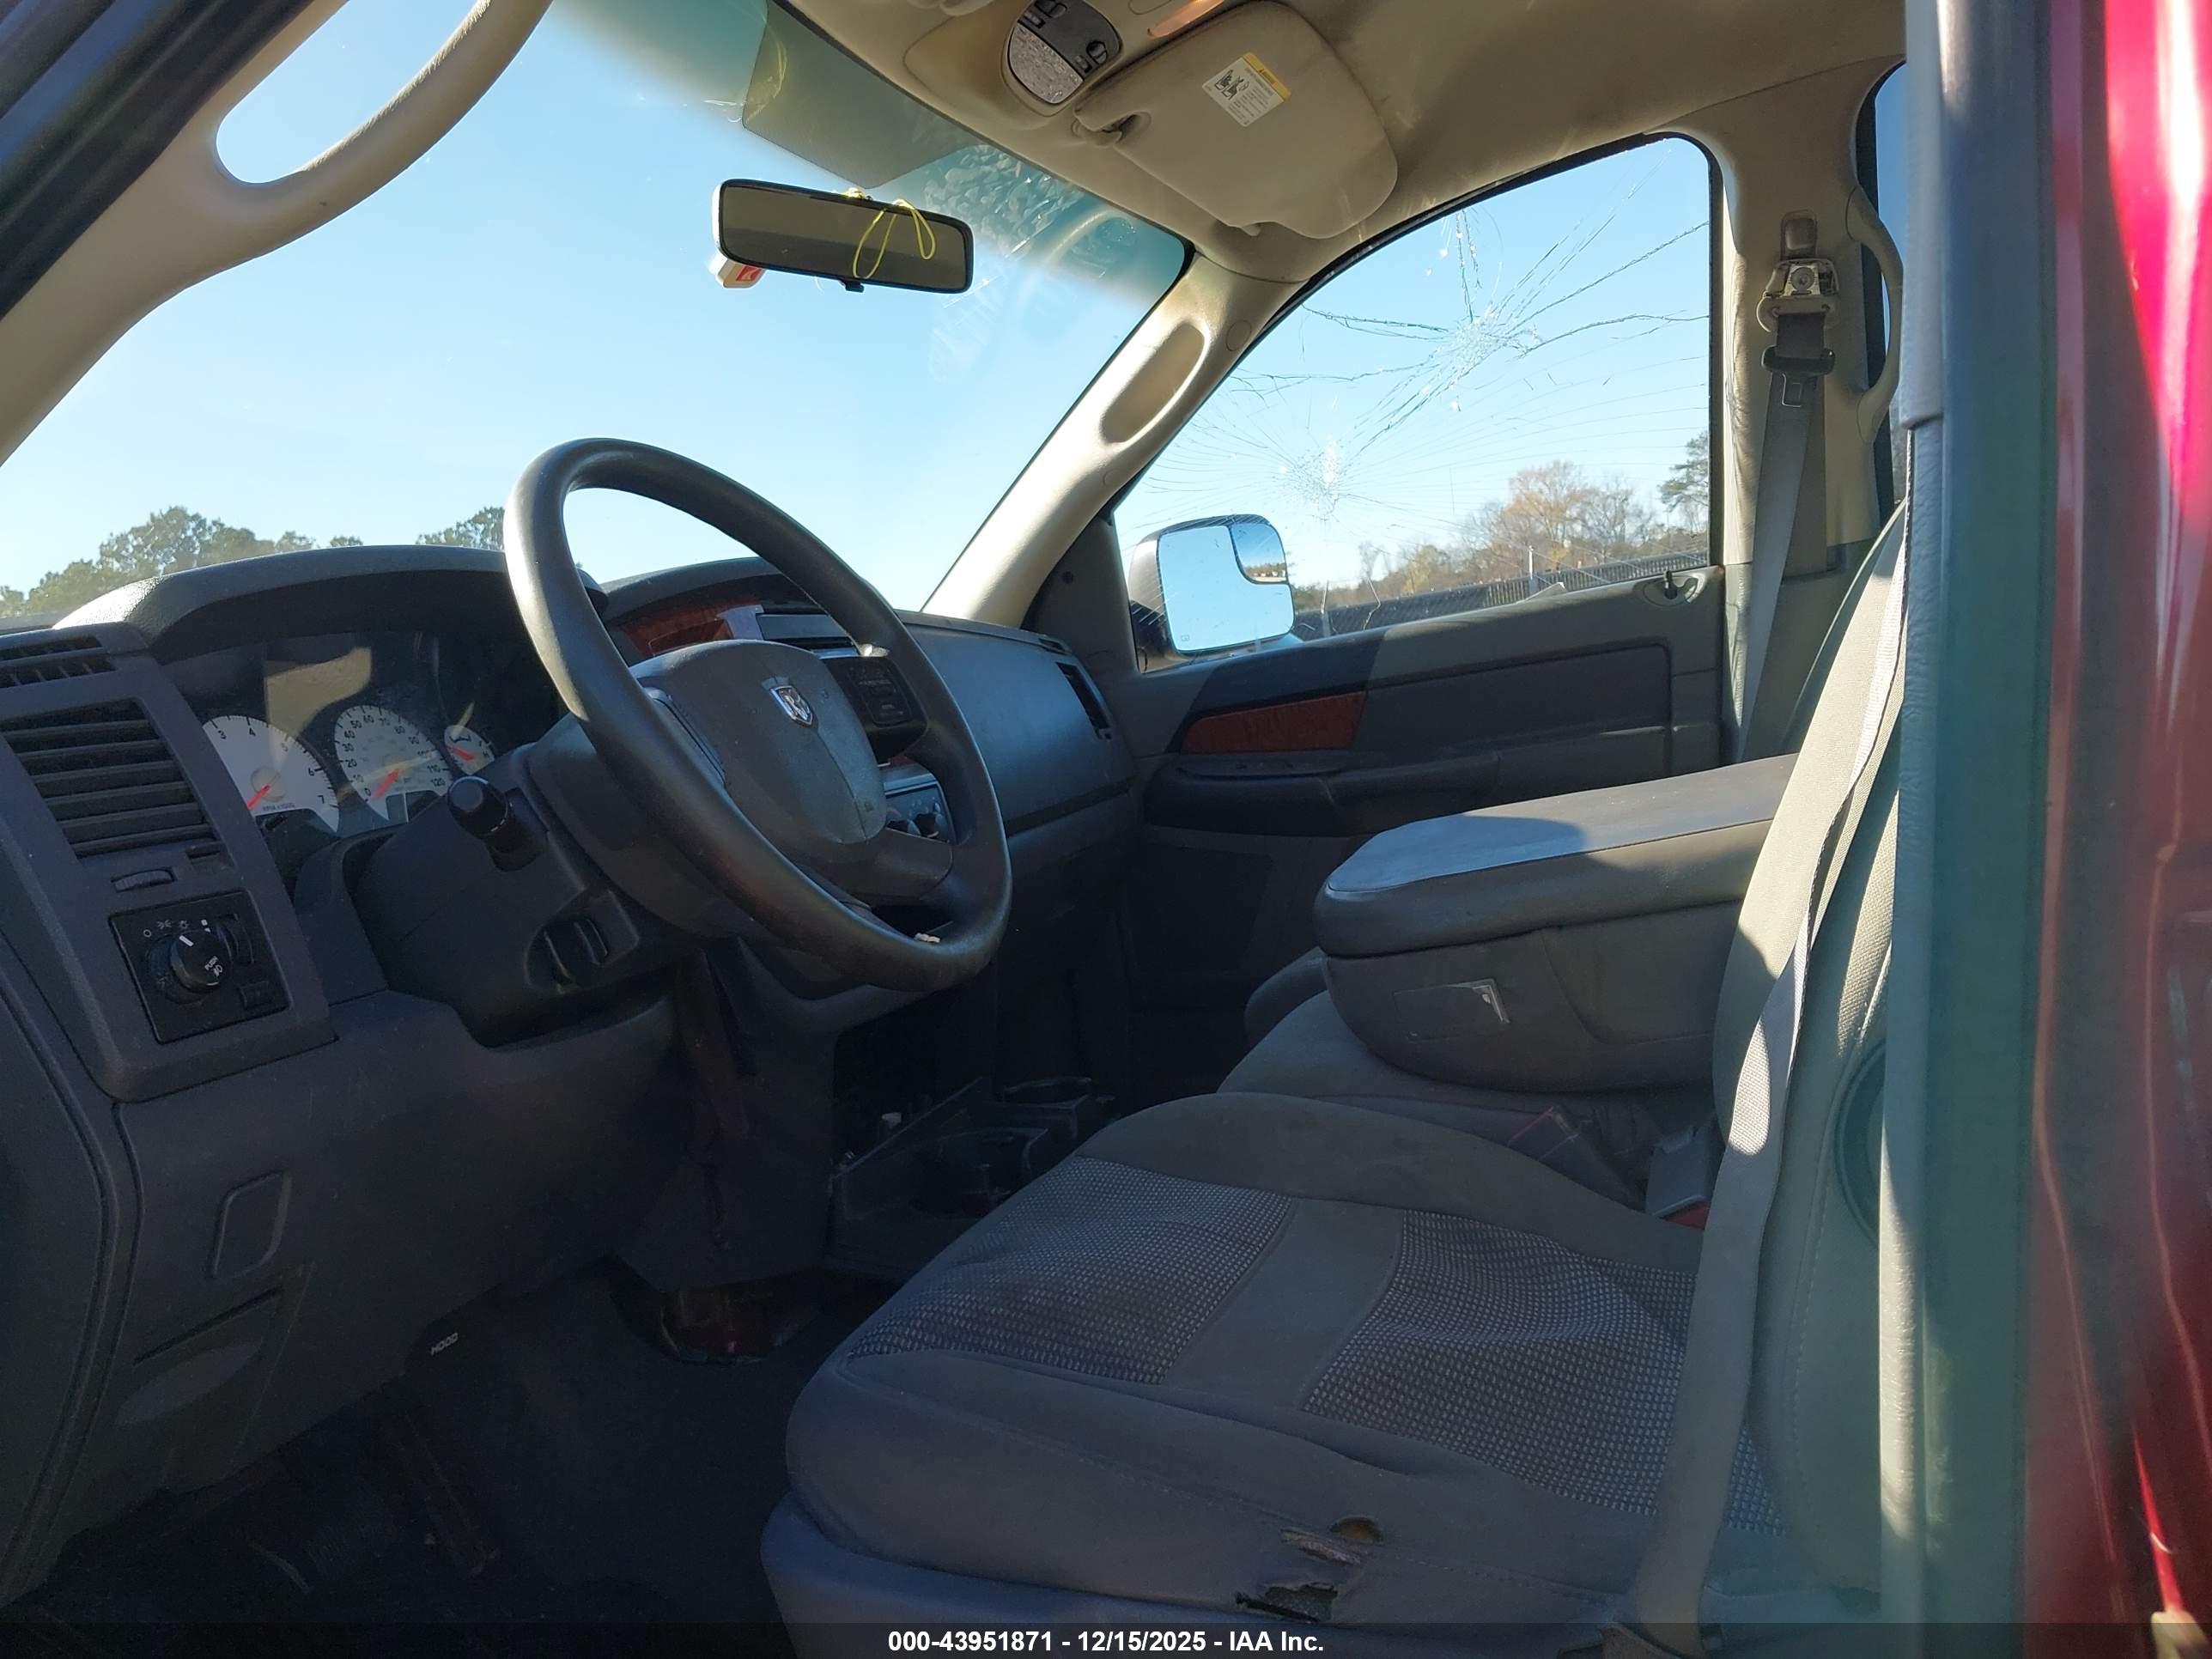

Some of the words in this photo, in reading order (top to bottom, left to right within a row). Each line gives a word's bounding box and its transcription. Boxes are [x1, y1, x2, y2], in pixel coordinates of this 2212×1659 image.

[349, 720, 362, 729] 50
[217, 729, 228, 740] 3
[248, 726, 257, 737] 4
[343, 730, 356, 739] 40
[342, 742, 355, 752] 30
[345, 758, 358, 769] 20
[307, 766, 316, 777] 6
[364, 787, 372, 797] 0
[317, 794, 325, 805] 7
[431, 1332, 459, 1356] HOOD
